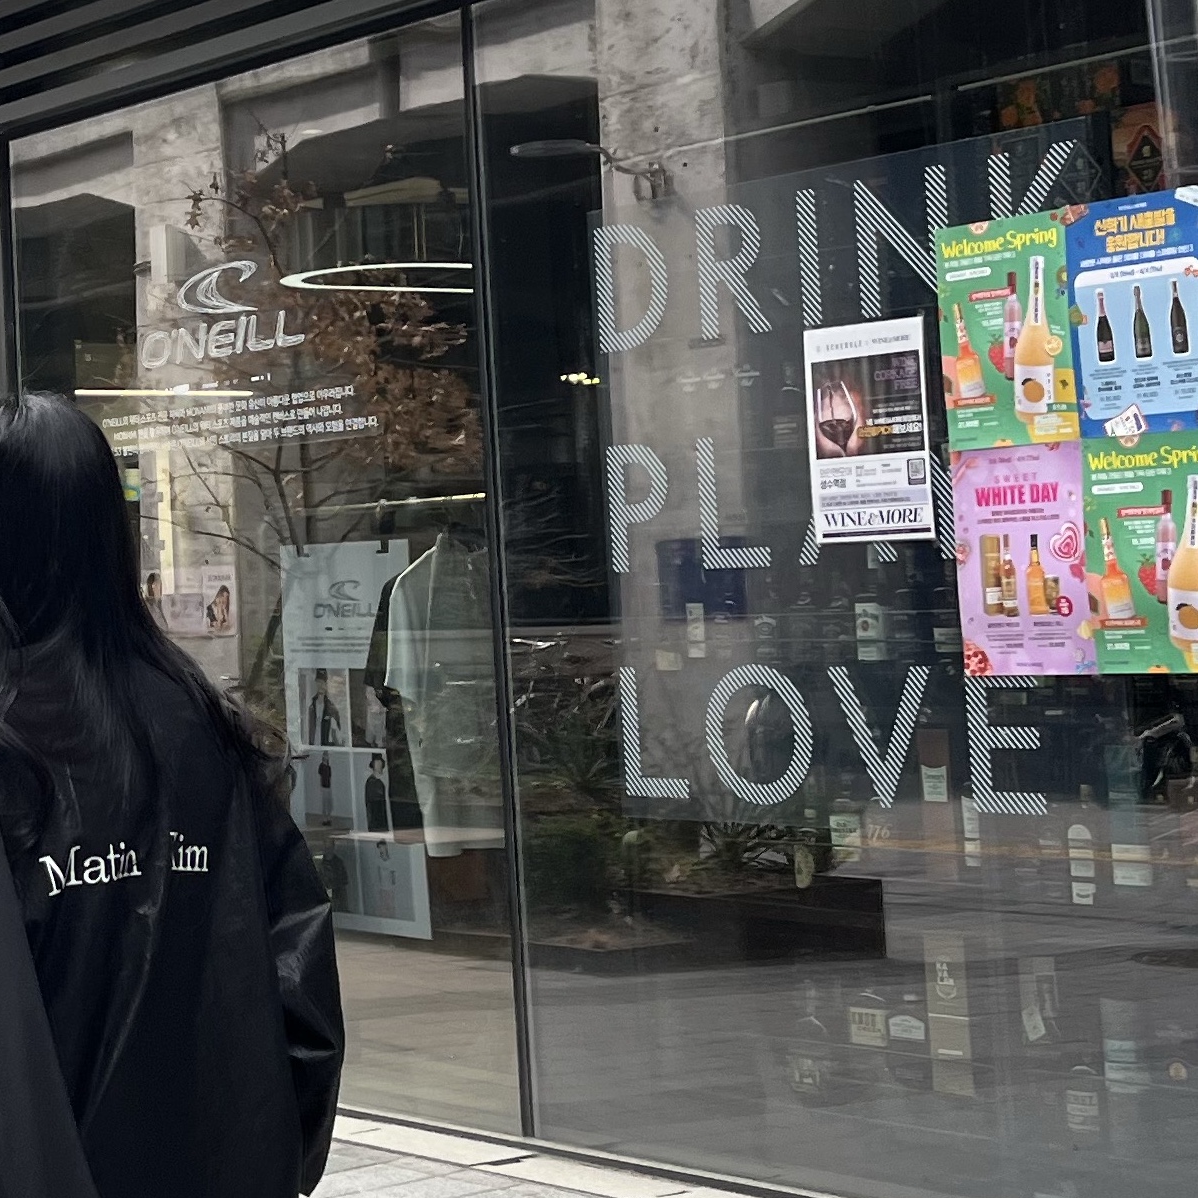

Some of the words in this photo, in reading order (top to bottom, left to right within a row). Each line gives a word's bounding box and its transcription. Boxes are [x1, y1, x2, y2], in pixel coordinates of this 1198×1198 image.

[941, 237, 1004, 259] Welcome
[1006, 227, 1057, 251] Spring
[1087, 450, 1158, 471] Welcome
[1160, 445, 1198, 469] Spri
[605, 436, 956, 574] PL
[975, 484, 1026, 507] WHITE
[1030, 481, 1059, 503] DAY
[823, 506, 924, 528] WINE&MORE
[620, 664, 1048, 815] LOVE
[38, 842, 142, 896] Matin
